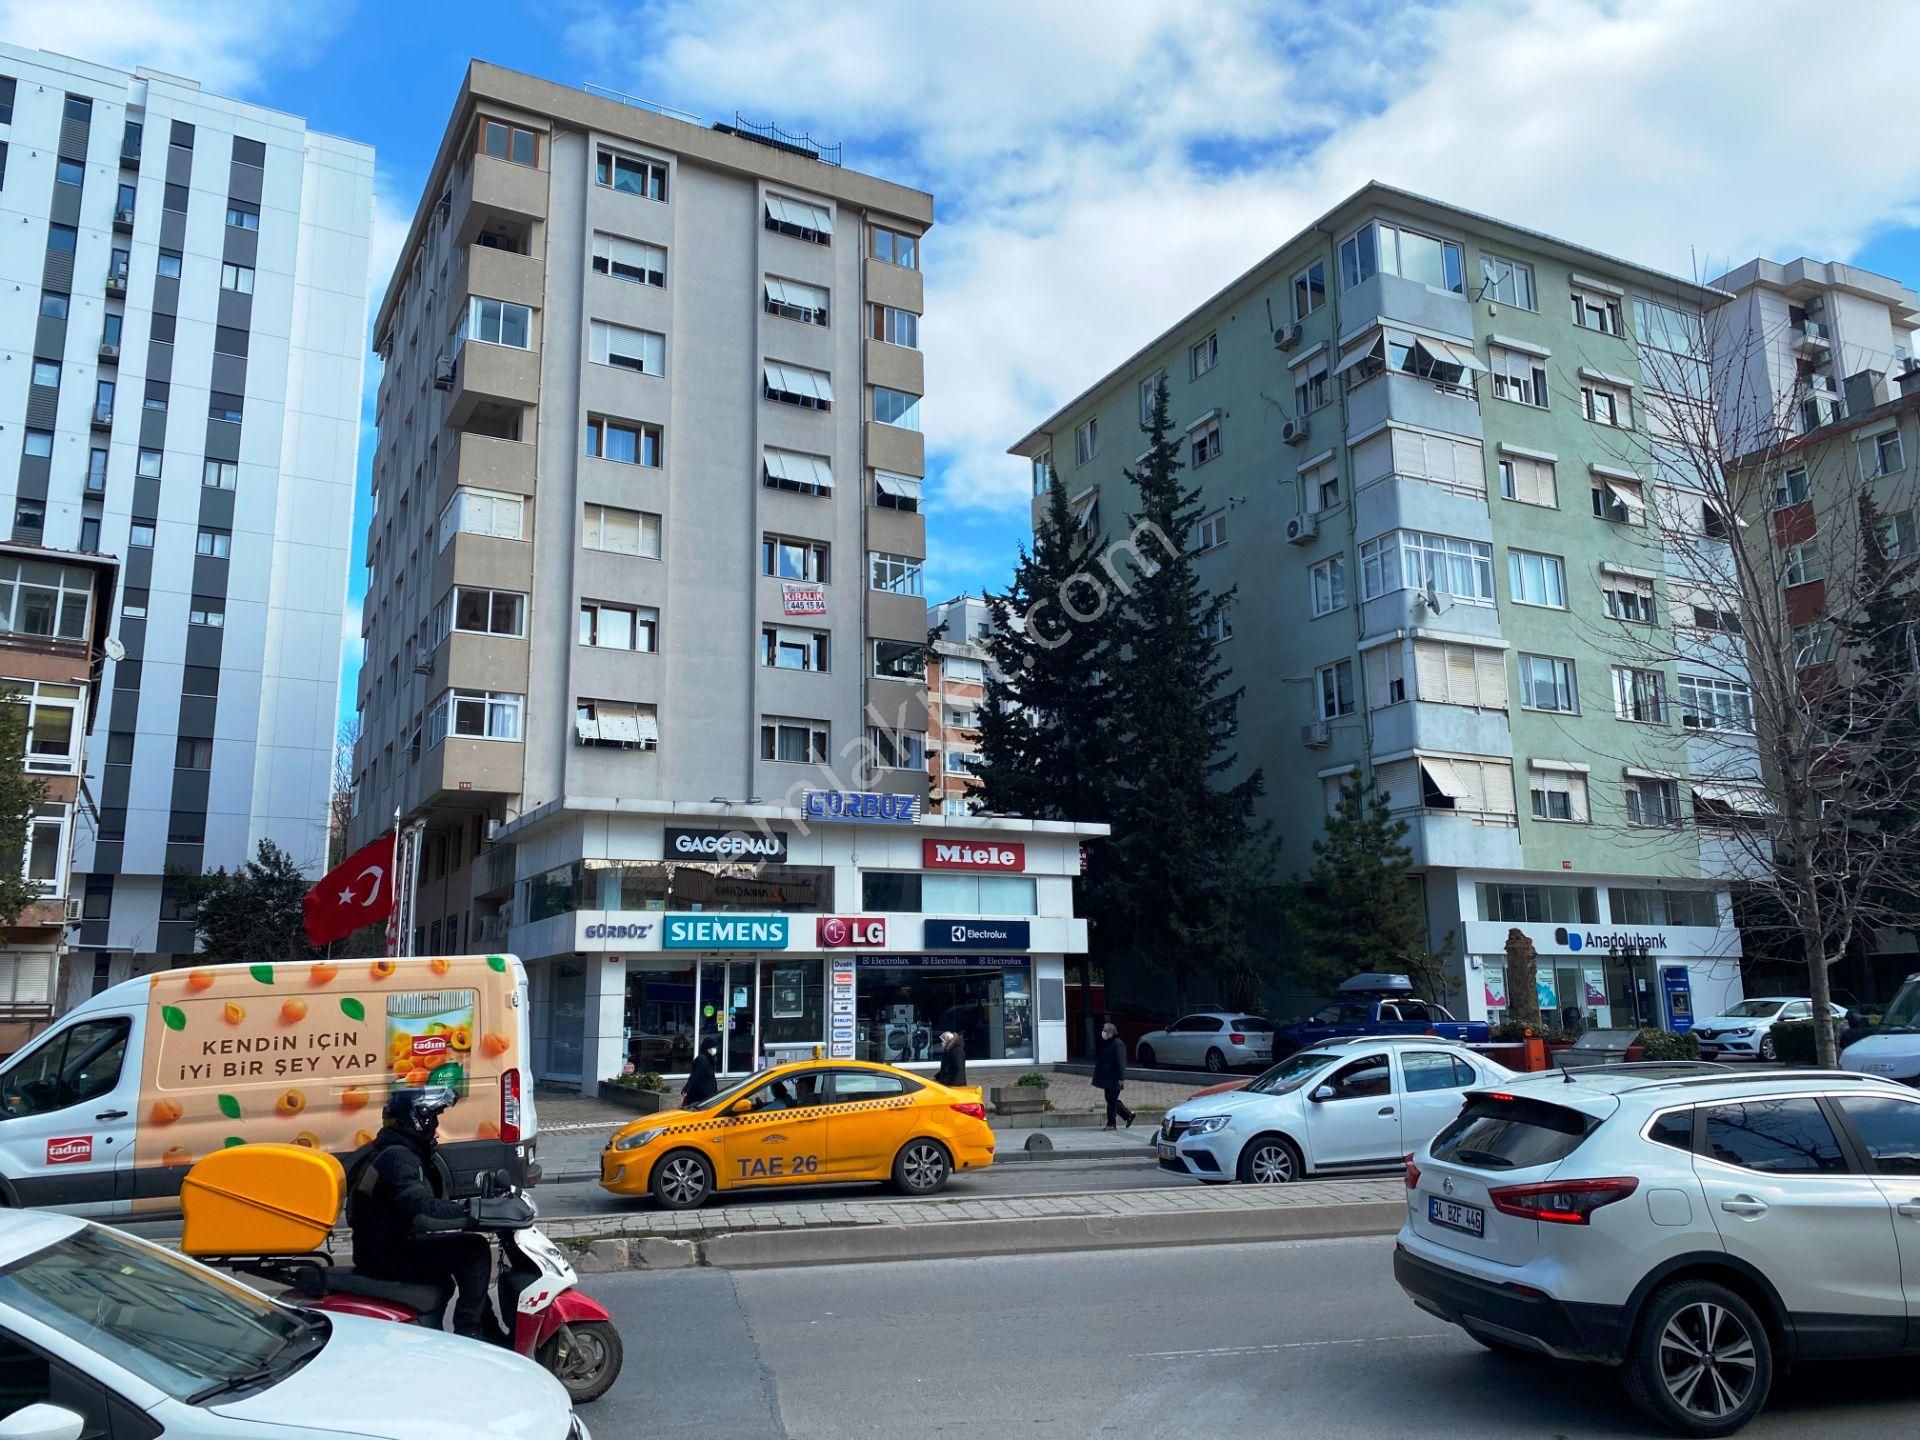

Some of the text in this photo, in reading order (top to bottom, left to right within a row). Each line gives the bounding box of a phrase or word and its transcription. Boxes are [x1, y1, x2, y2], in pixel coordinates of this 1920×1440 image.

[675, 835, 779, 855] GAGGENAU
[936, 845, 1016, 866] Miele
[671, 922, 783, 942] SIEMENS
[853, 922, 884, 943] LG
[967, 930, 1007, 939] Electrolux
[1585, 931, 1668, 949] Anadolubank
[871, 957, 909, 965] Electrolux
[930, 957, 967, 965] Electrolux
[987, 957, 1022, 965] Electrolux
[274, 1056, 321, 1076] ŞEY
[332, 1053, 377, 1070] YAP
[737, 1155, 817, 1177] TAE 26
[1434, 1201, 1481, 1229] 34 BZF 446
